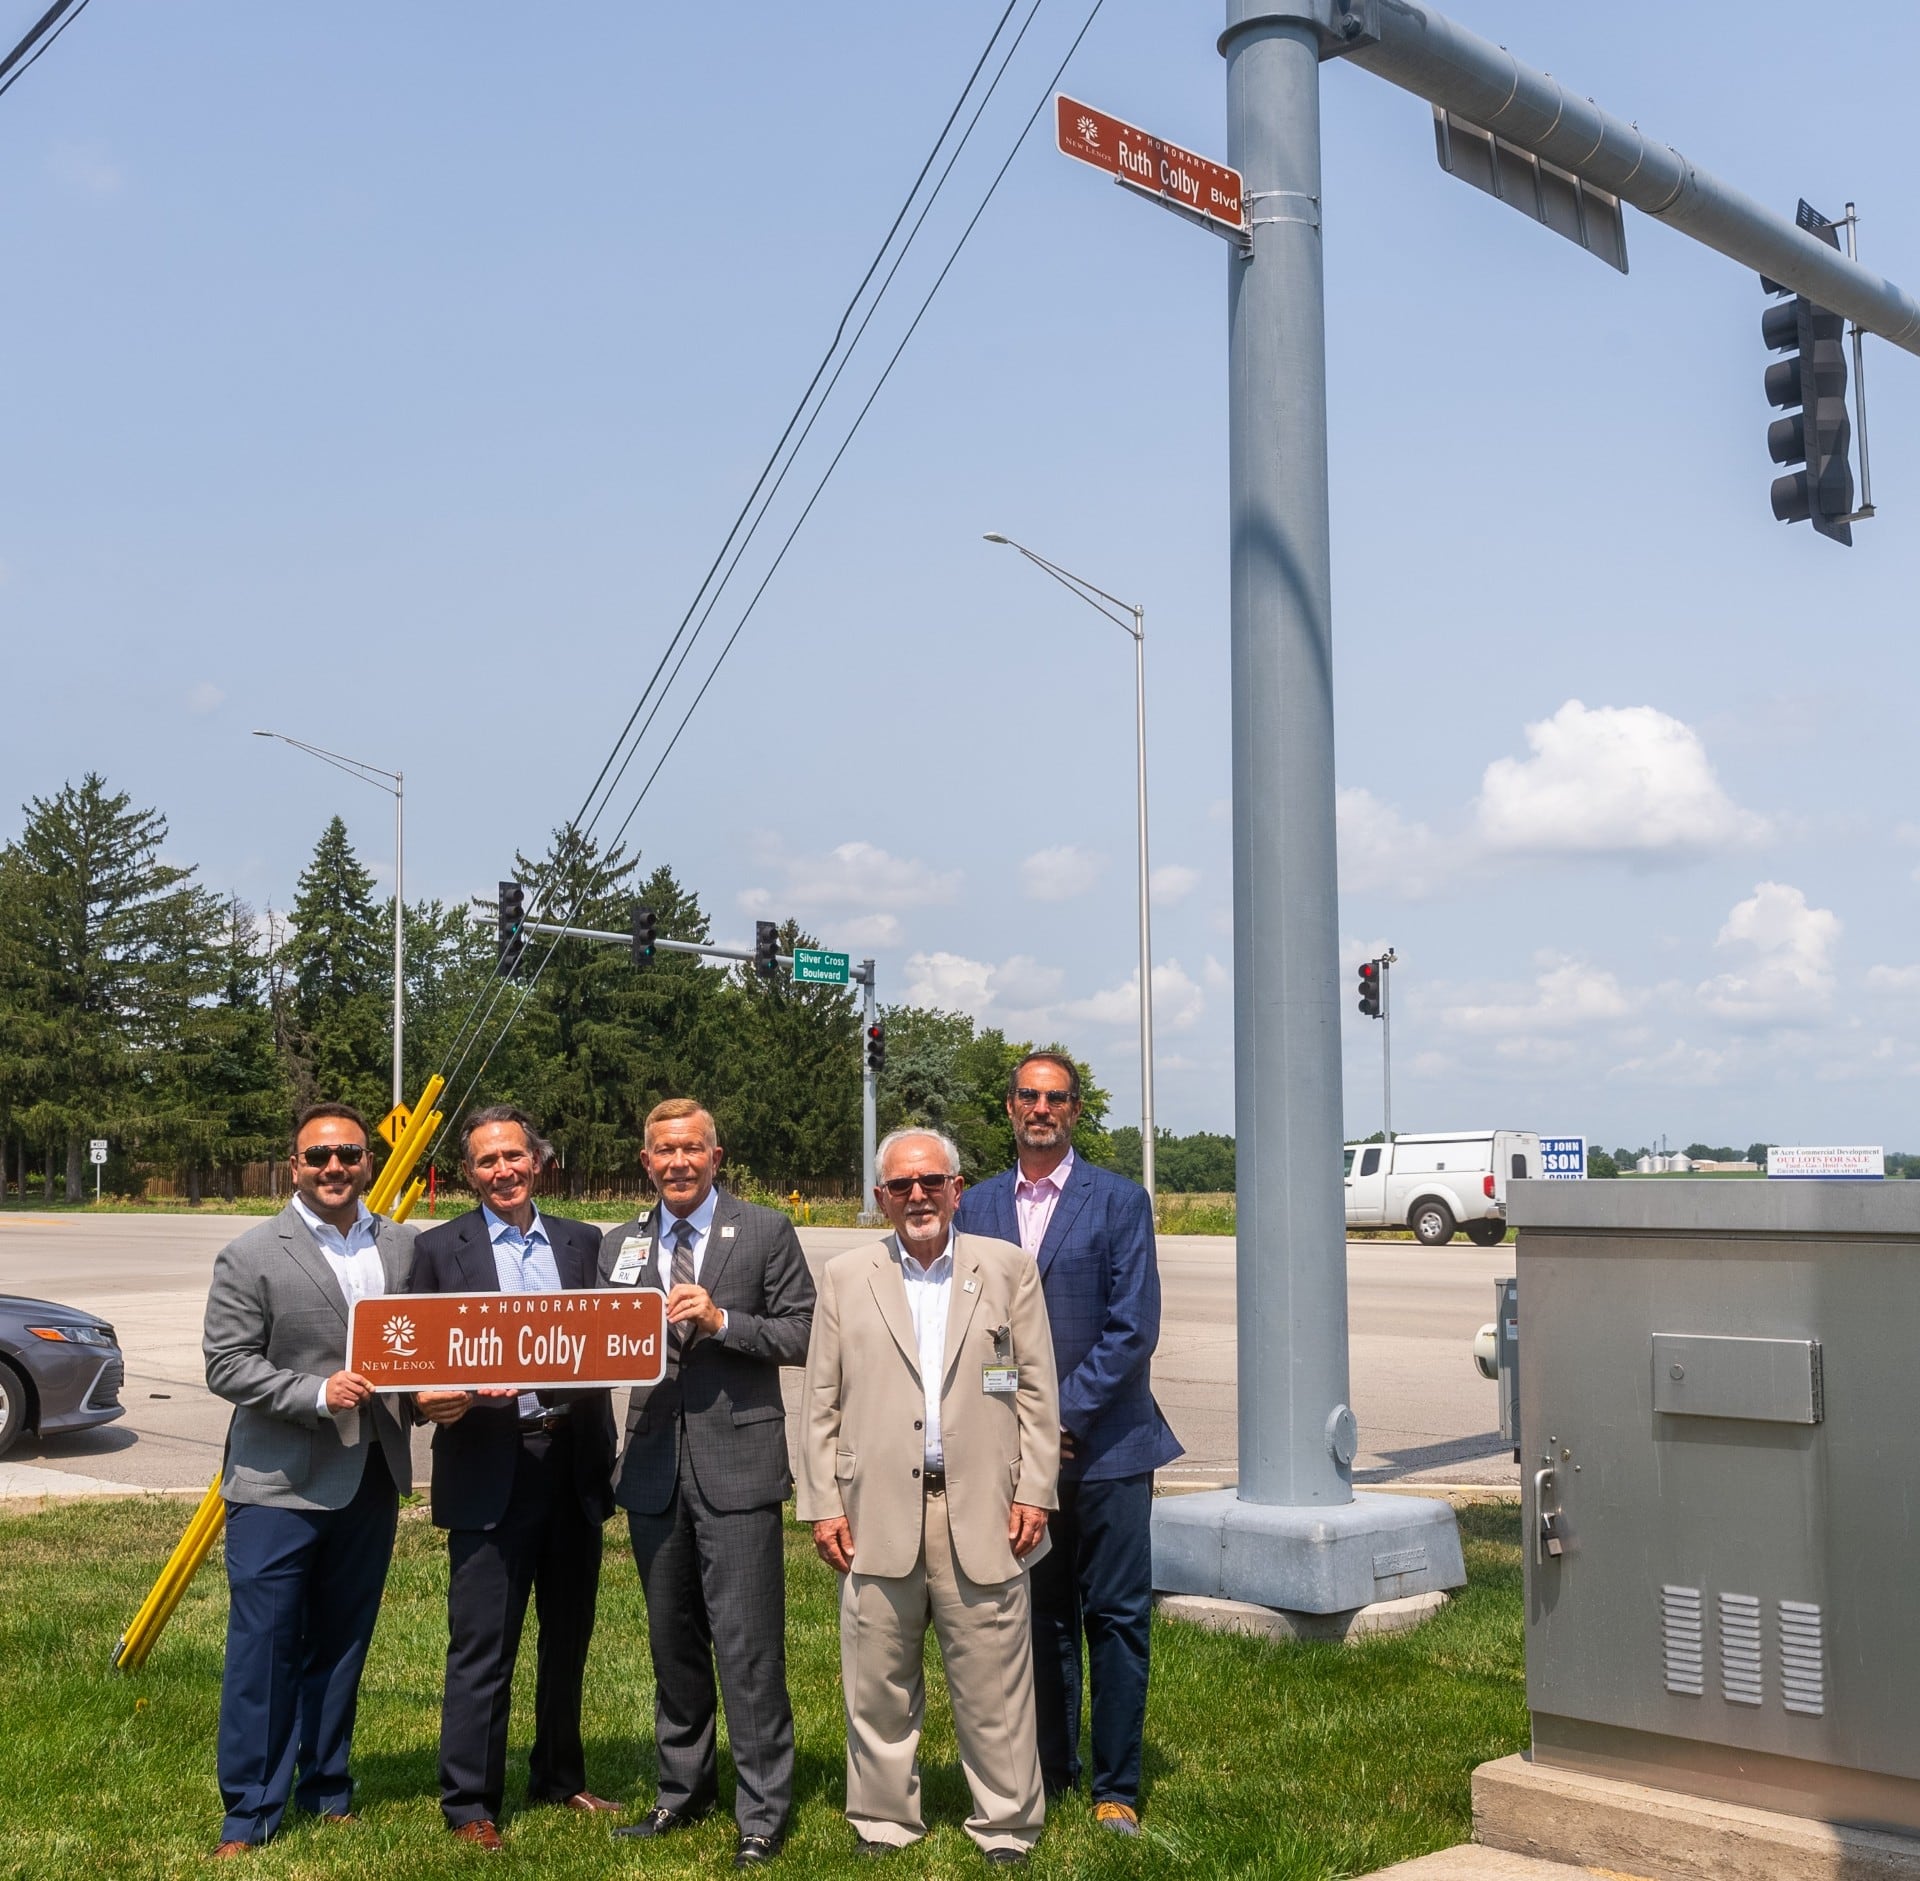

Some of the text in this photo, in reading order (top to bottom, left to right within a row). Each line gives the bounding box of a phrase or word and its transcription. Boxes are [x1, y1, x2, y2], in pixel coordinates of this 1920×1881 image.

[1147, 137, 1207, 170] HONORARY
[1118, 140, 1238, 211] Ruth Colby Blvd
[799, 952, 845, 966] Silver Cross
[802, 967, 841, 980] Boulevard
[1553, 1142, 1579, 1152] JOHN
[1837, 1148, 1880, 1157] Development
[96, 1151, 102, 1161] 6
[499, 1298, 601, 1314] HONORARY
[448, 1324, 655, 1375] Ruth Colby Blvd
[361, 1360, 436, 1371] NEW LENOX
